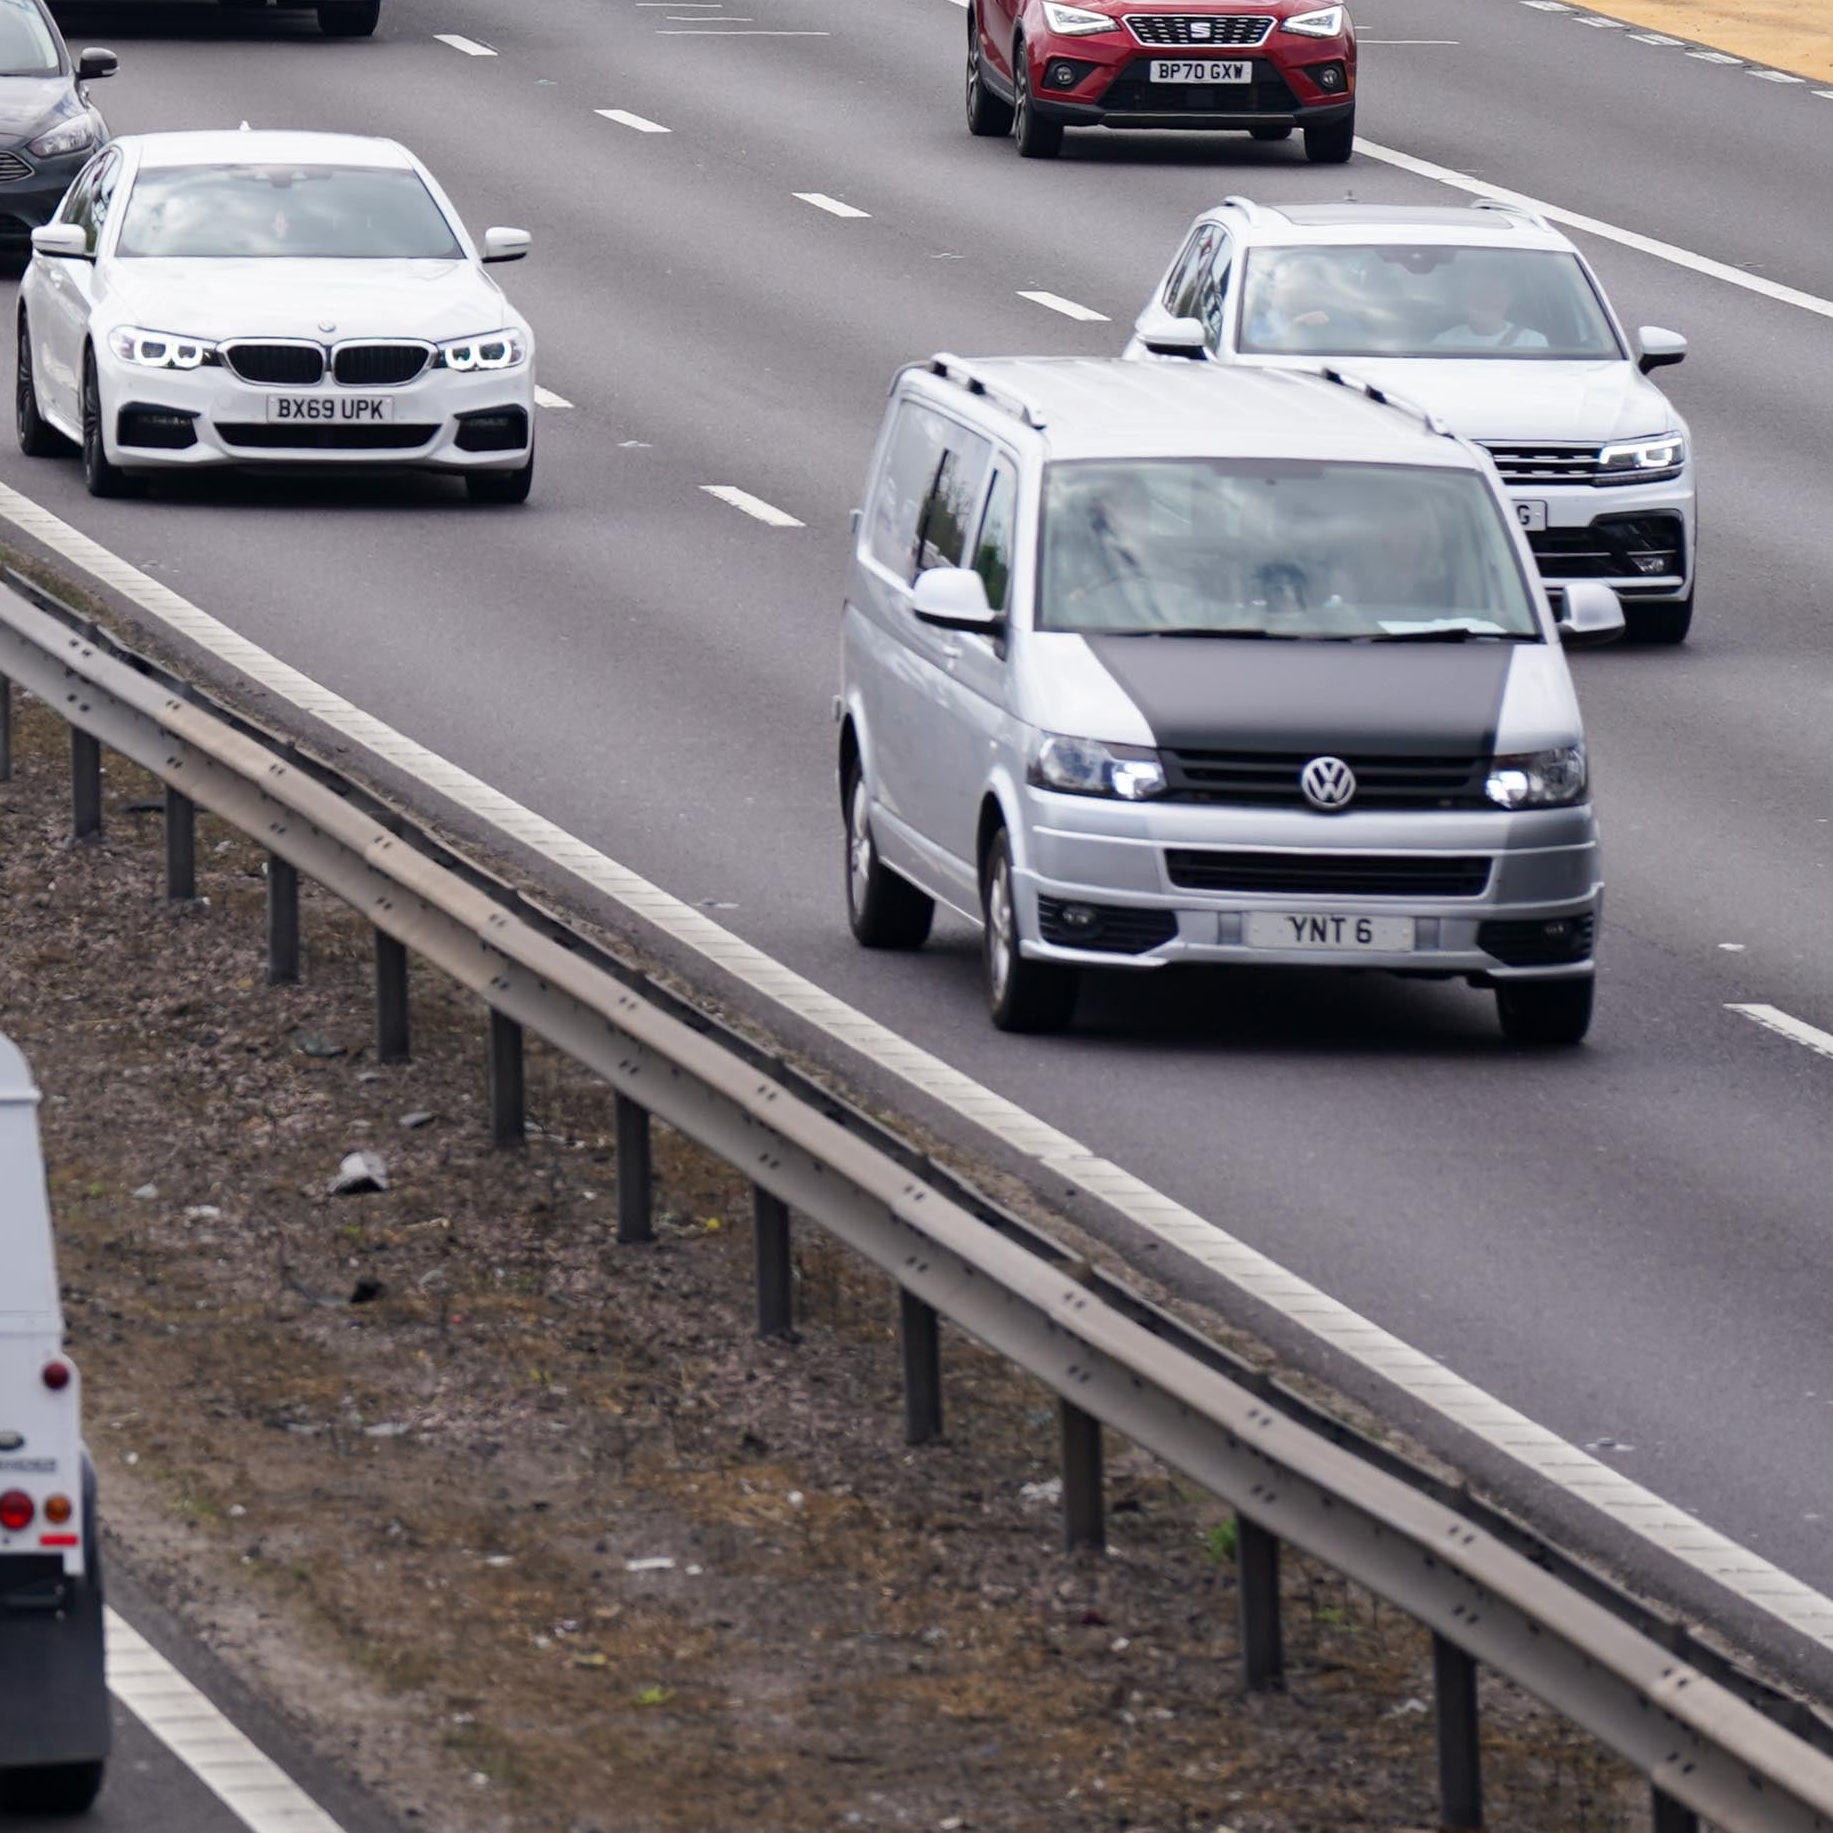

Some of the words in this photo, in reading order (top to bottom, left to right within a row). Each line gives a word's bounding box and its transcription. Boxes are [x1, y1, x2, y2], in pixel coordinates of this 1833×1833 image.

[1159, 64, 1204, 80] BP70
[1210, 64, 1243, 80] GXW
[277, 399, 334, 420] BX69
[341, 399, 383, 420] UPK
[1288, 917, 1345, 945] YNT
[1355, 919, 1373, 945] 6
